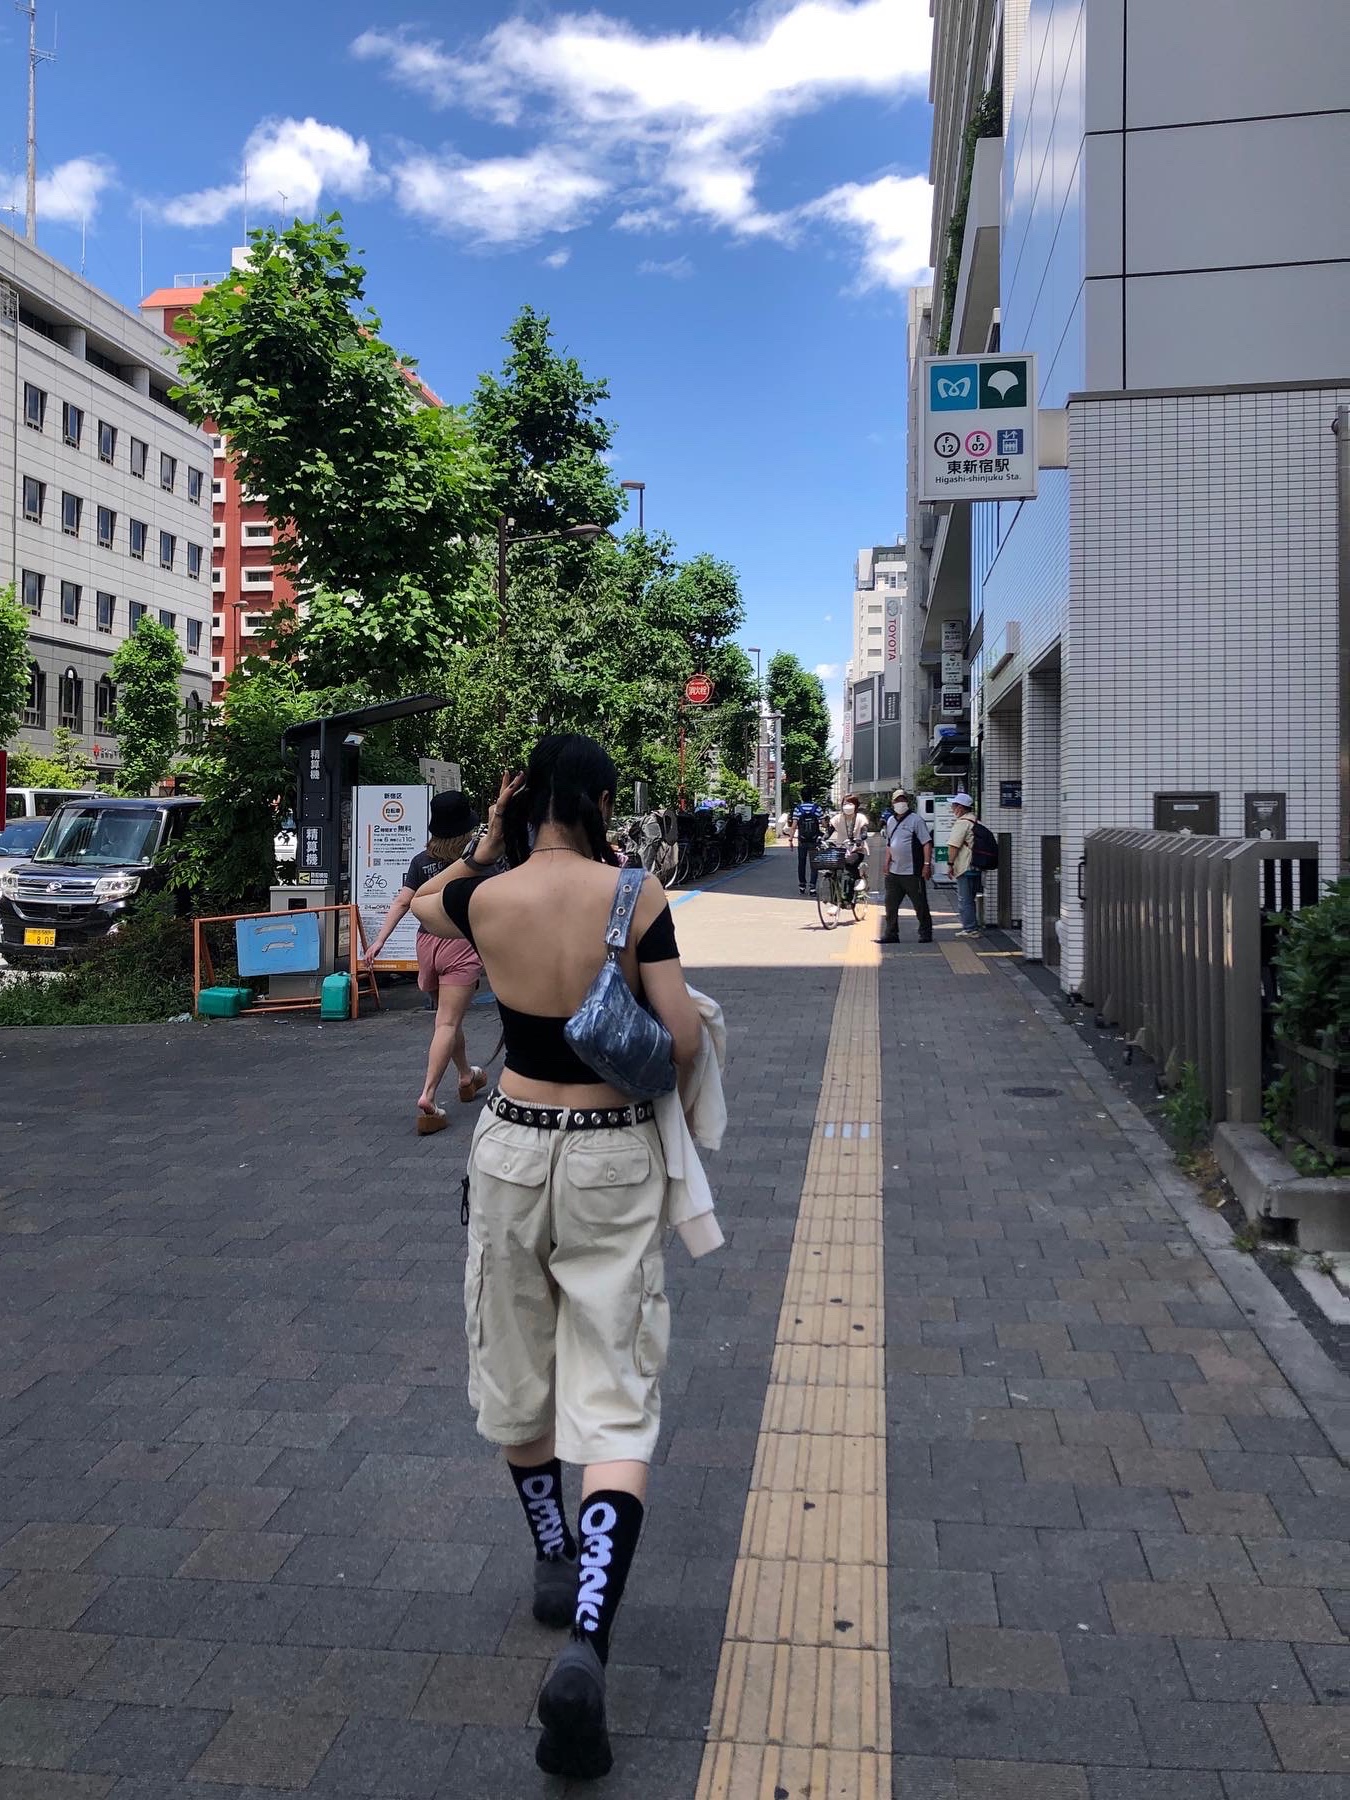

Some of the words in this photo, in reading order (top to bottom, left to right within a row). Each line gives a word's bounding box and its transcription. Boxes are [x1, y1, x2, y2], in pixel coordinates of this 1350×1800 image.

[972, 443, 984, 451] 02
[947, 459, 1009, 474] 東新宿駅
[936, 475, 1003, 484] Higashi-shinjuku
[888, 619, 897, 661] TOYOTA
[310, 749, 320, 780] 精算機
[306, 828, 318, 866] 精算機
[422, 862, 438, 875] THE
